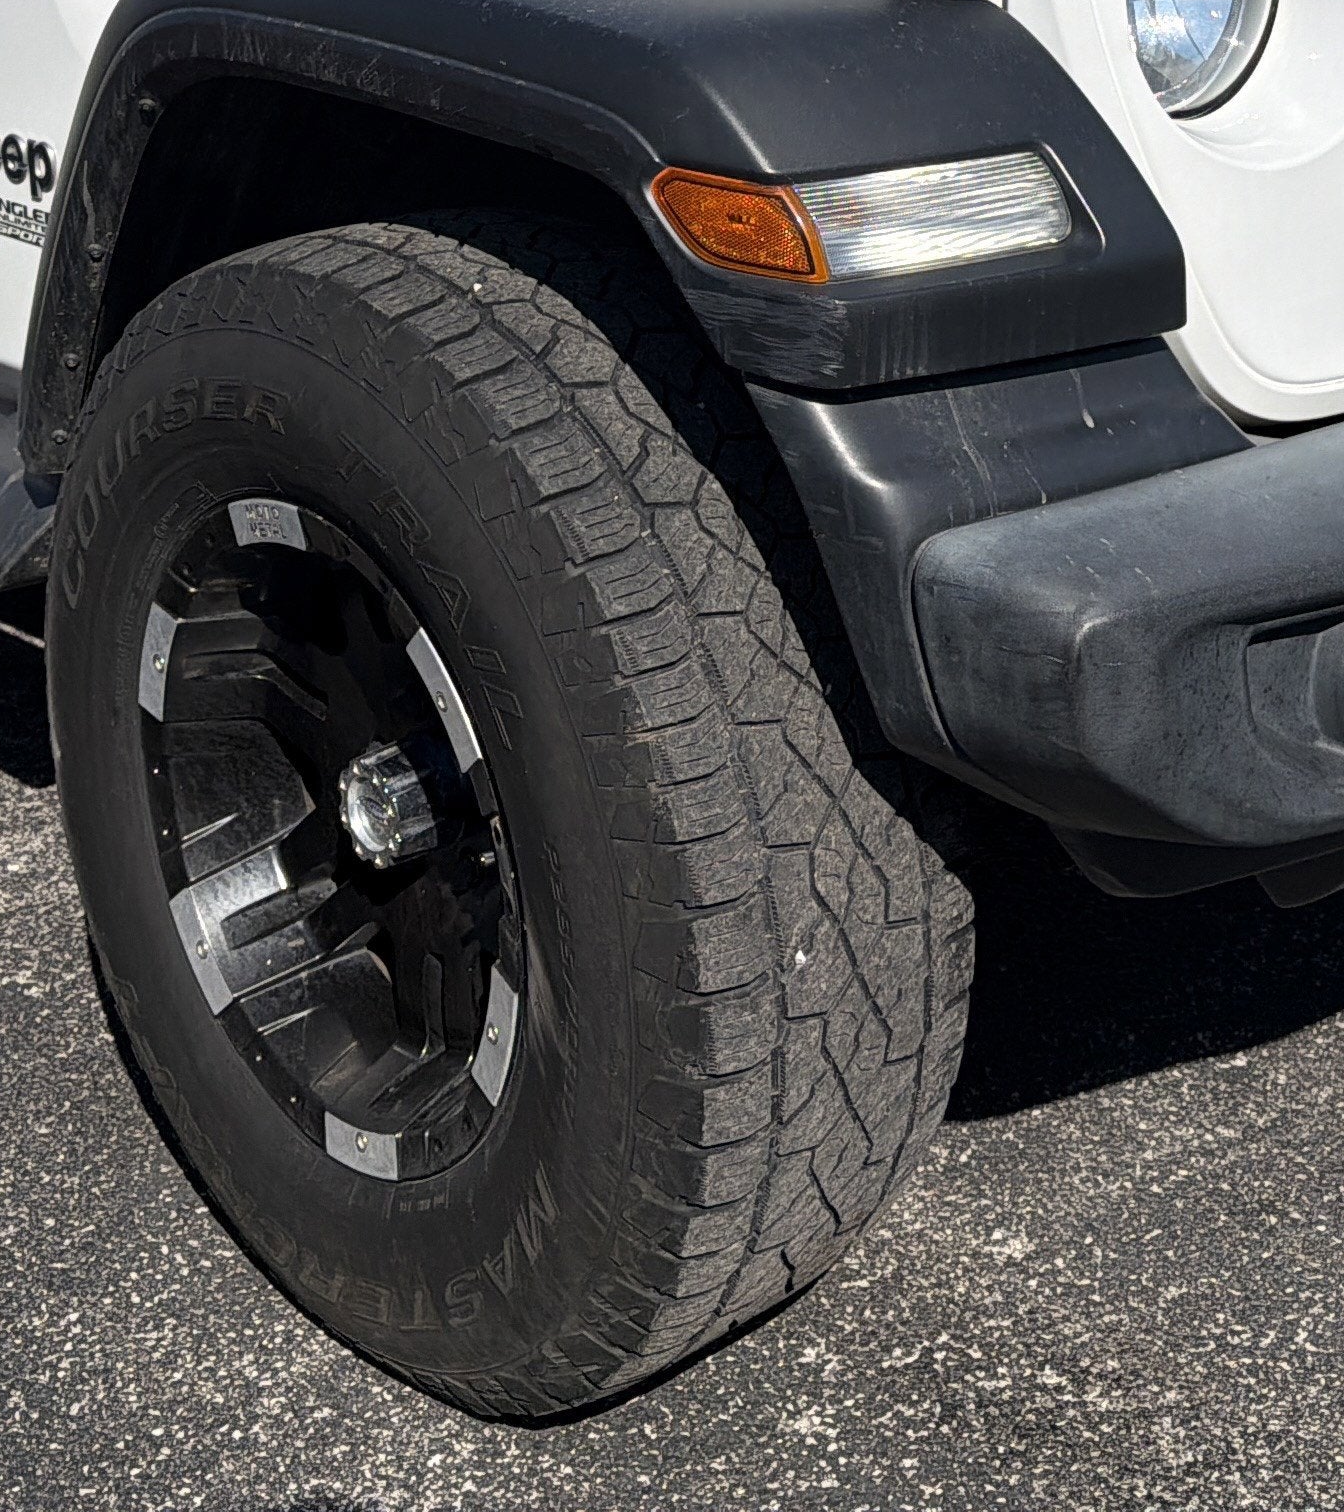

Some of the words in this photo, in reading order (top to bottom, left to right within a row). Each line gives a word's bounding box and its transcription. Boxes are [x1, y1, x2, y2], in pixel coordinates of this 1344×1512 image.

[61, 375, 292, 610] COURSER
[336, 431, 524, 751] TRAIL
[244, 503, 281, 521] MOTO
